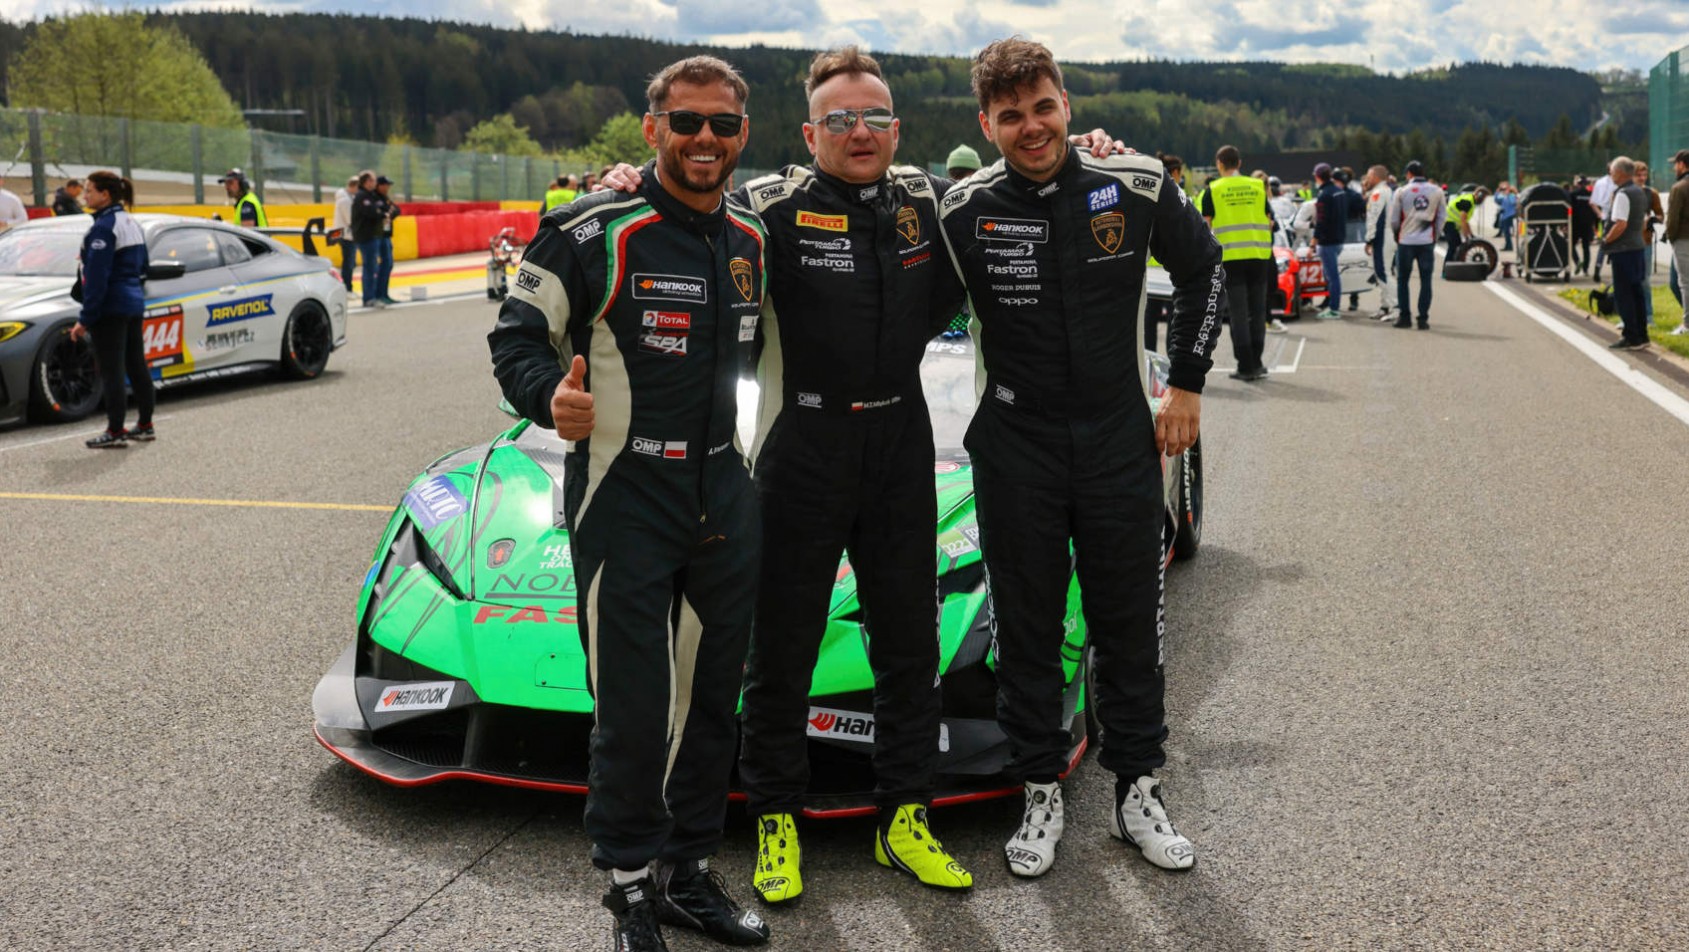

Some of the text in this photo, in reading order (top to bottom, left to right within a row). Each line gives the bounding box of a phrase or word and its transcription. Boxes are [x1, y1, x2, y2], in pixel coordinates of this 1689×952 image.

[907, 180, 927, 192] OMP
[1133, 178, 1156, 190] OMP
[760, 186, 785, 199] OMP
[859, 186, 879, 199] OMP
[944, 192, 965, 207] OMP
[1090, 184, 1117, 205] 24H
[1091, 197, 1118, 211] SERIES
[800, 213, 843, 229] PIRELLI
[574, 221, 601, 240] OMP
[801, 256, 855, 268] Fastron
[987, 264, 1038, 274] Fastron
[518, 272, 541, 289] OMP
[212, 300, 270, 321] RAVENOL
[644, 335, 687, 353] SPA
[632, 439, 662, 453] OMP
[626, 890, 644, 902] OMP
